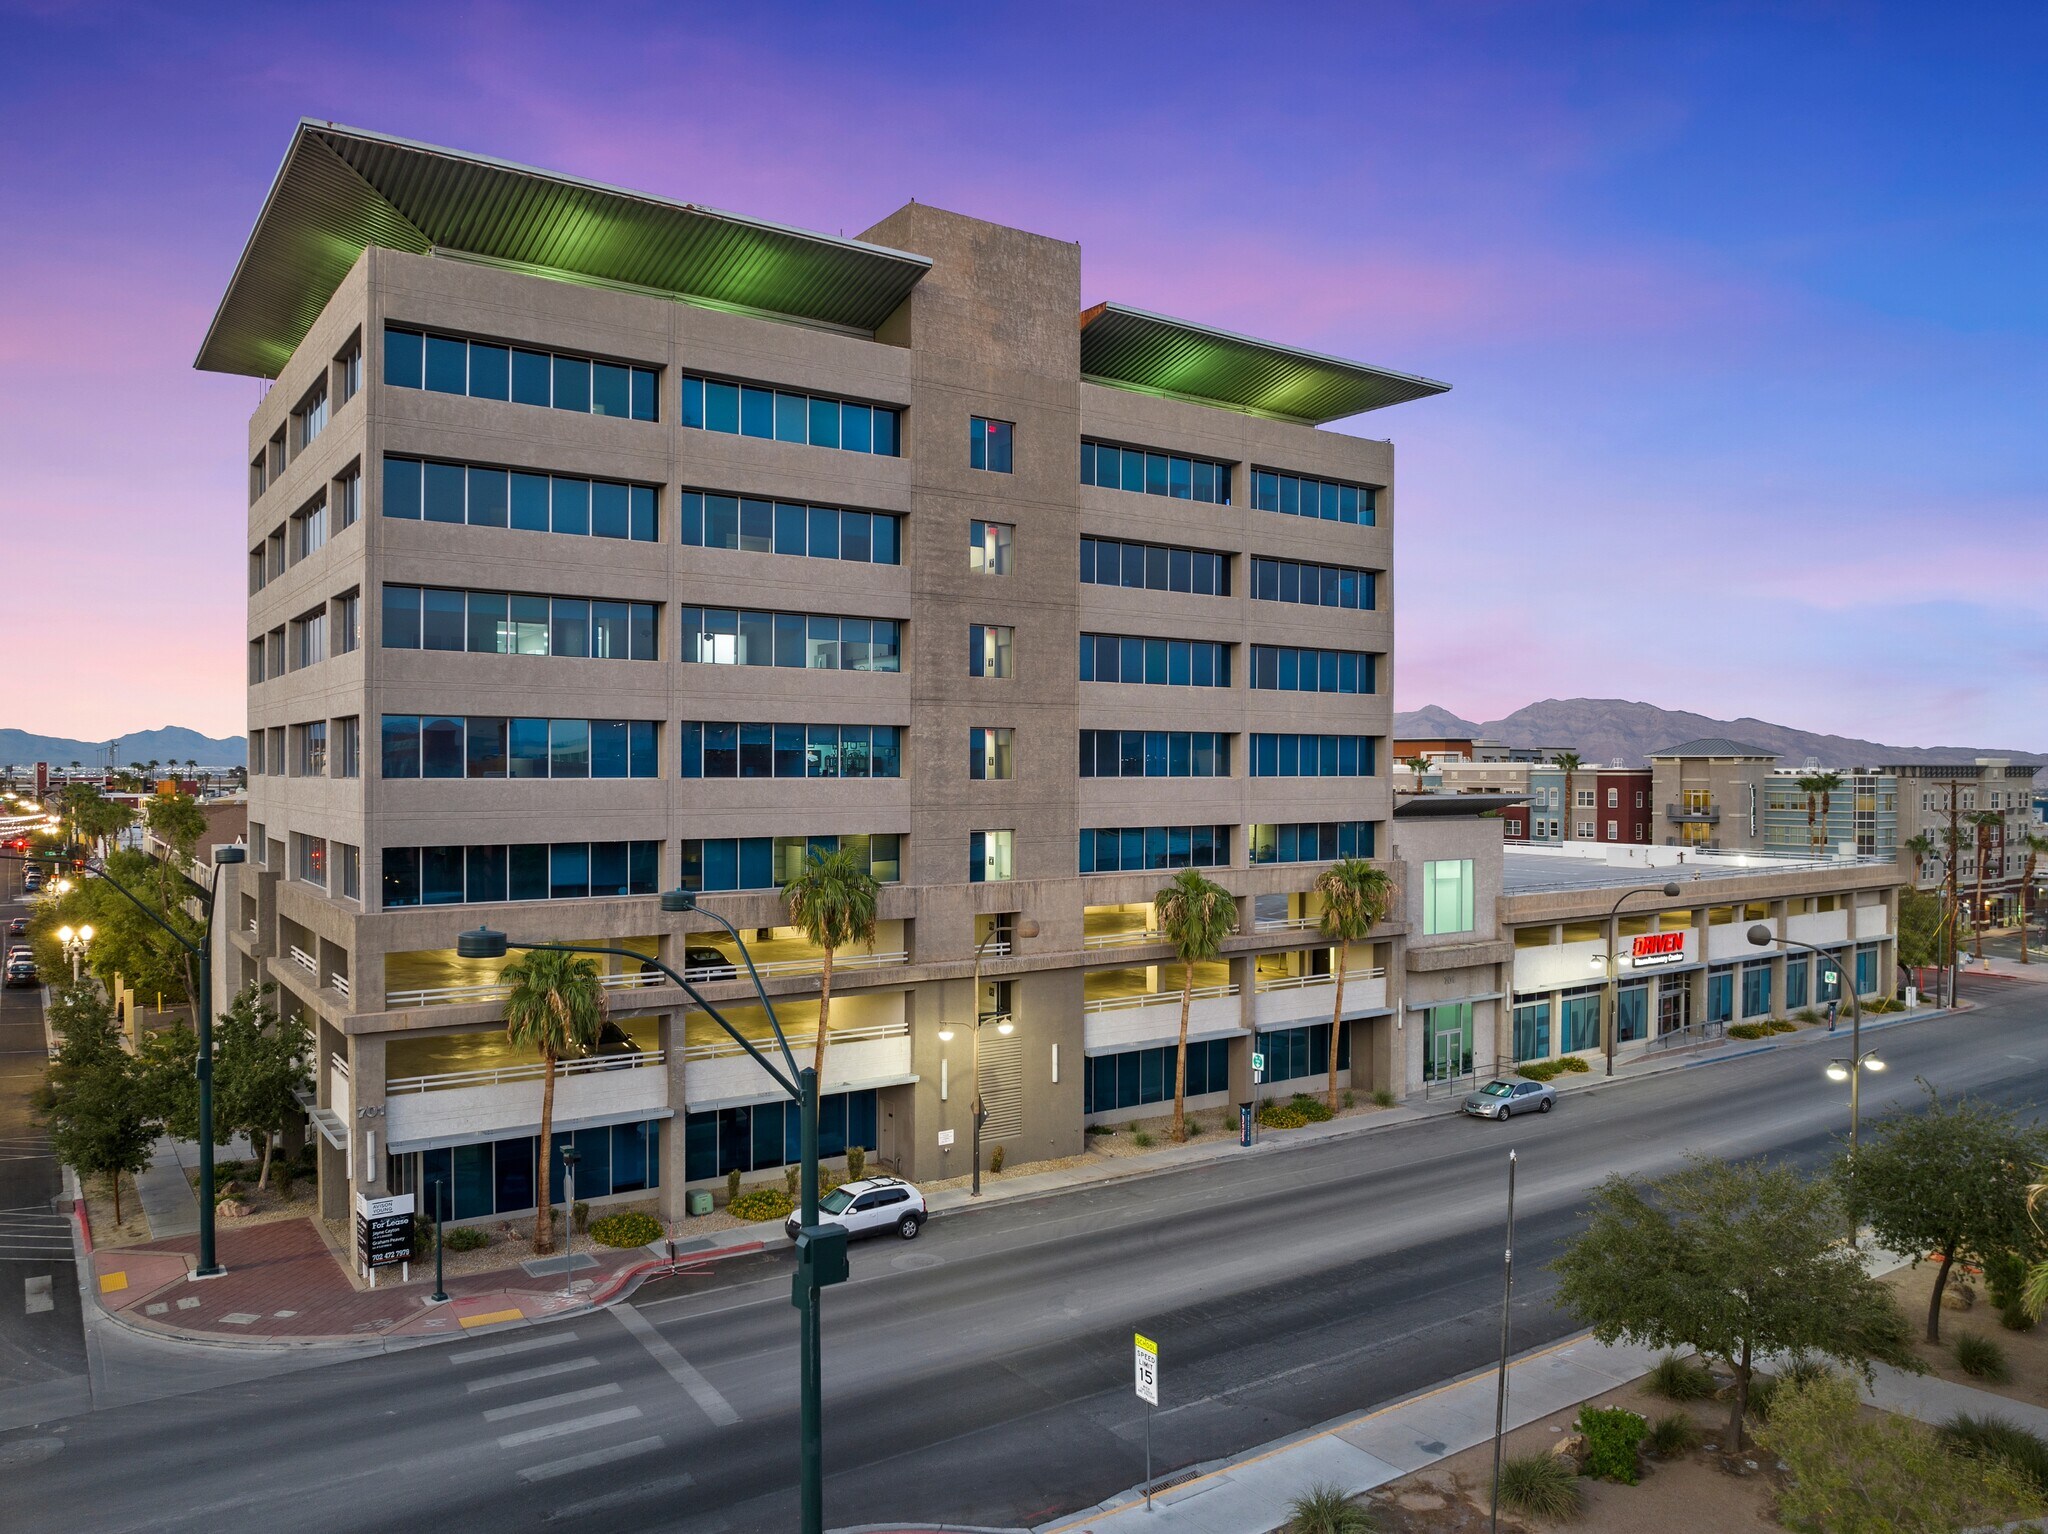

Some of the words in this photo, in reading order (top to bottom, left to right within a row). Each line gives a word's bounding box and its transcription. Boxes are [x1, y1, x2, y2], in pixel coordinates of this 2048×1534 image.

[1633, 932, 1685, 956] DRIVEN
[357, 1104, 385, 1119] 701
[372, 1221, 385, 1230] For
[386, 1218, 409, 1227] Lease
[372, 1253, 384, 1262] 702
[384, 1251, 396, 1259] 472
[1136, 1337, 1155, 1352] SCHOOL
[1137, 1350, 1155, 1364] SPEED
[1138, 1358, 1153, 1371] LIMIT
[1140, 1367, 1153, 1385] 15
